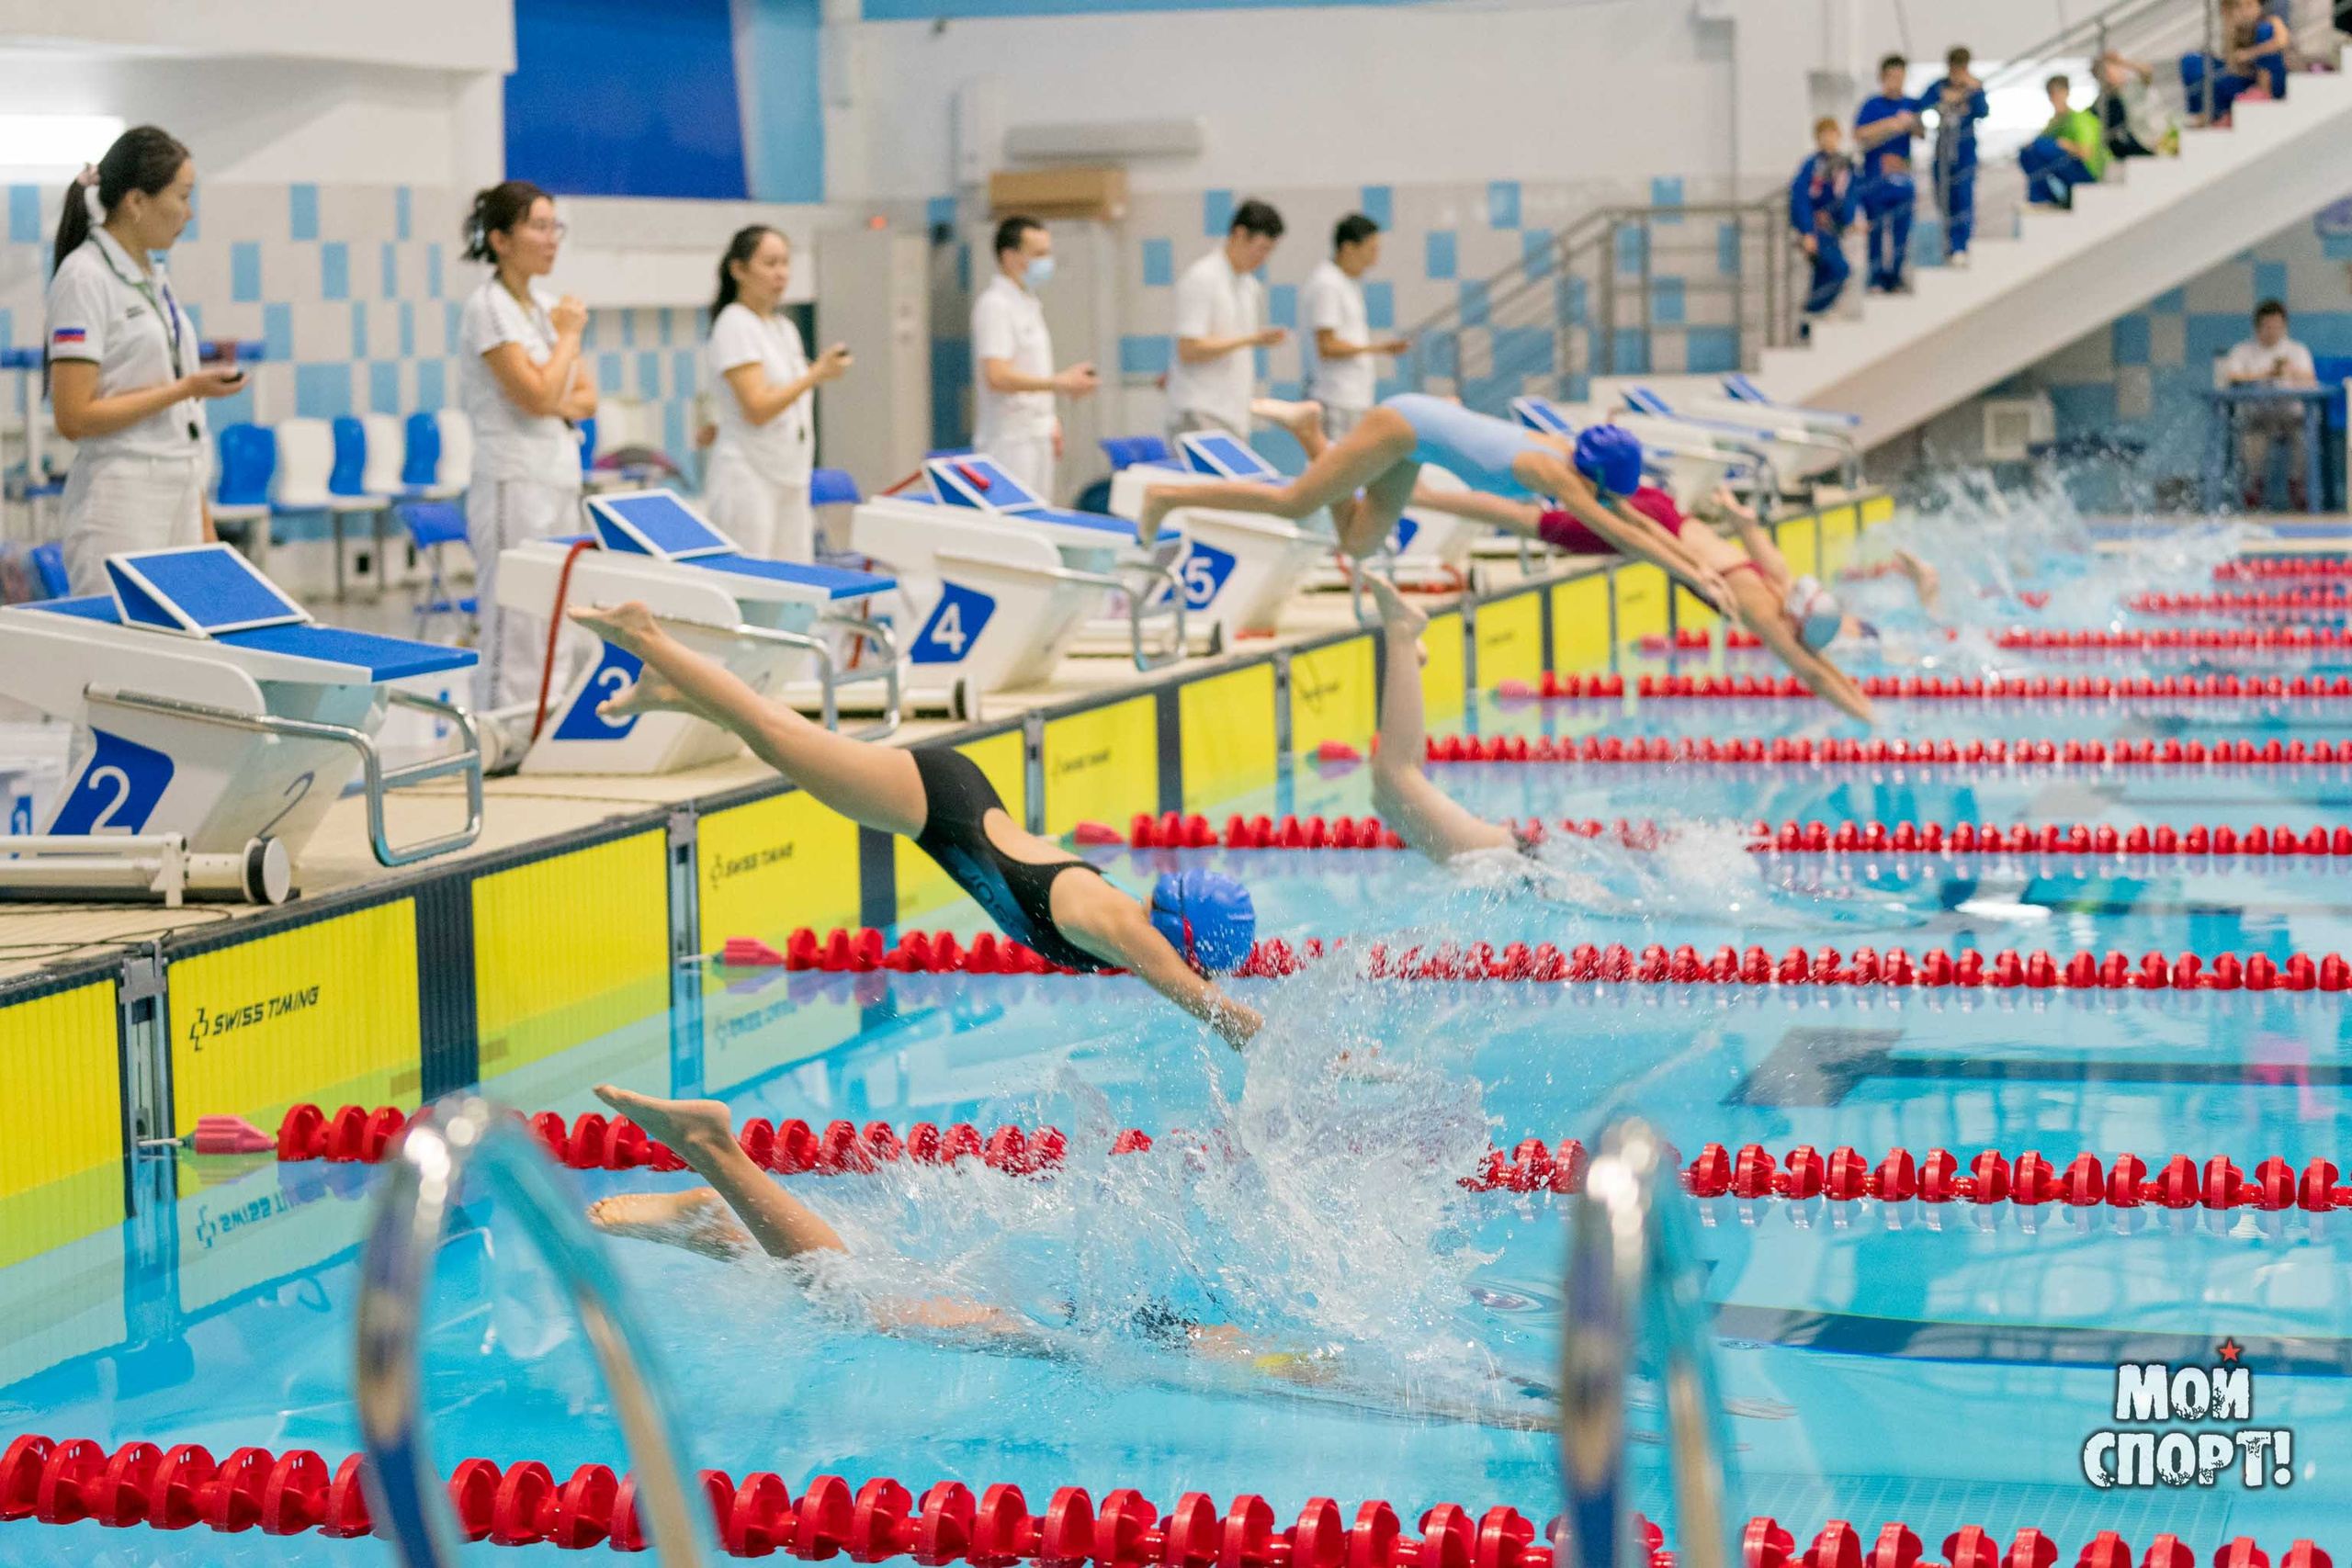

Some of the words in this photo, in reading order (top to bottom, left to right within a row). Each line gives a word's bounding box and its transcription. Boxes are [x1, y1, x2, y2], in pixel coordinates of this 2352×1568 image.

[1186, 557, 1216, 604] 5
[931, 602, 967, 654] 4
[598, 666, 633, 728] 3
[88, 765, 132, 835] 2
[212, 1002, 265, 1036] SWISS
[267, 985, 320, 1021] TIMING
